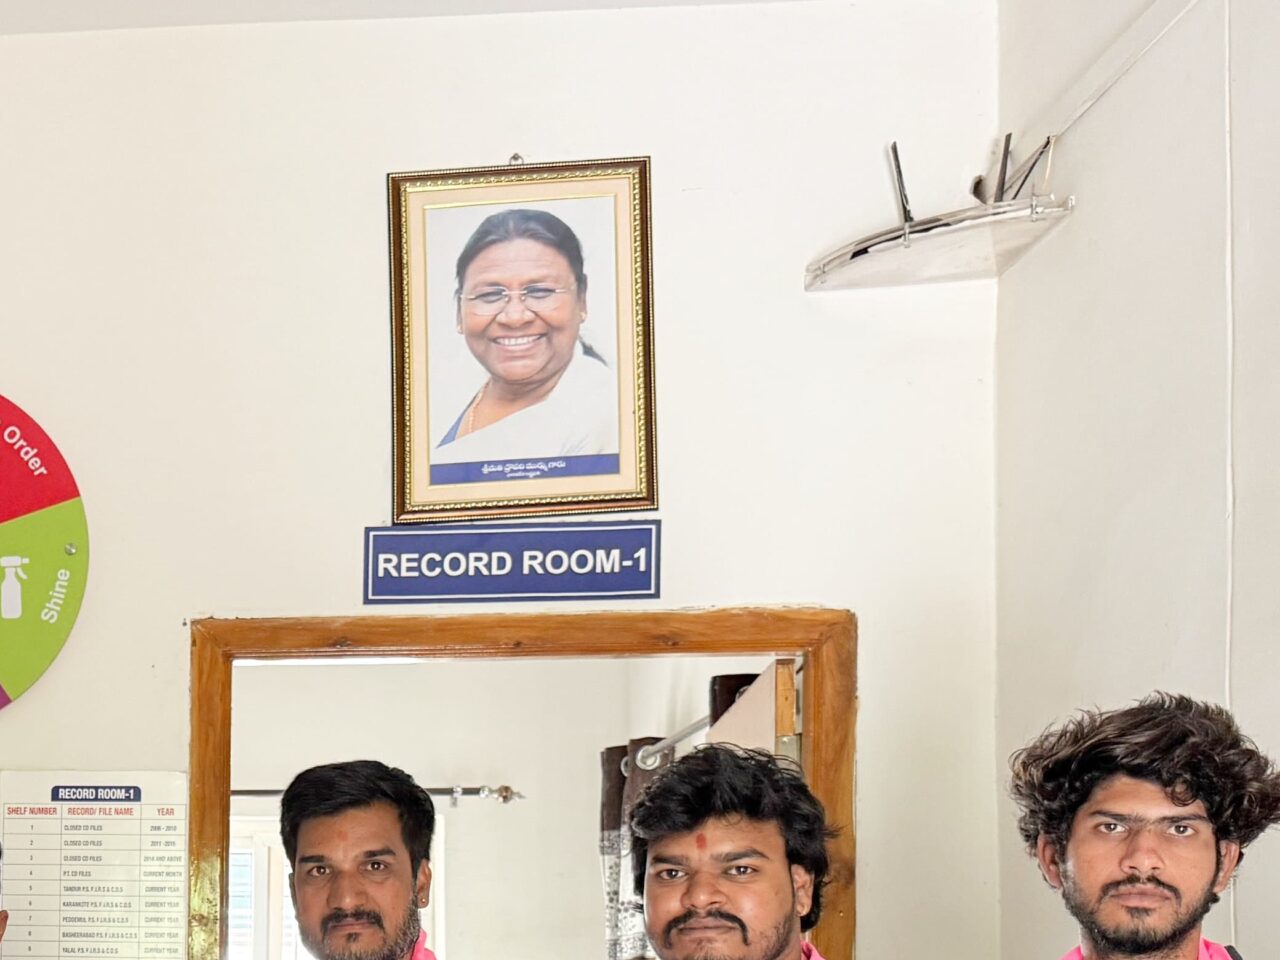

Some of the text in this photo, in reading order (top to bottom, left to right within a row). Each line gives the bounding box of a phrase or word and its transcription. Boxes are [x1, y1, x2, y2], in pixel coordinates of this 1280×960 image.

[3, 426, 47, 477] Order
[377, 547, 647, 577] RECORD ROOM-1
[41, 568, 70, 624] Shine
[58, 788, 134, 799] RECORD ROOM-1
[7, 807, 57, 816] SHELF NUMBER
[68, 808, 134, 816] RECORD/ FILE NAME
[157, 808, 174, 816] YEAR
